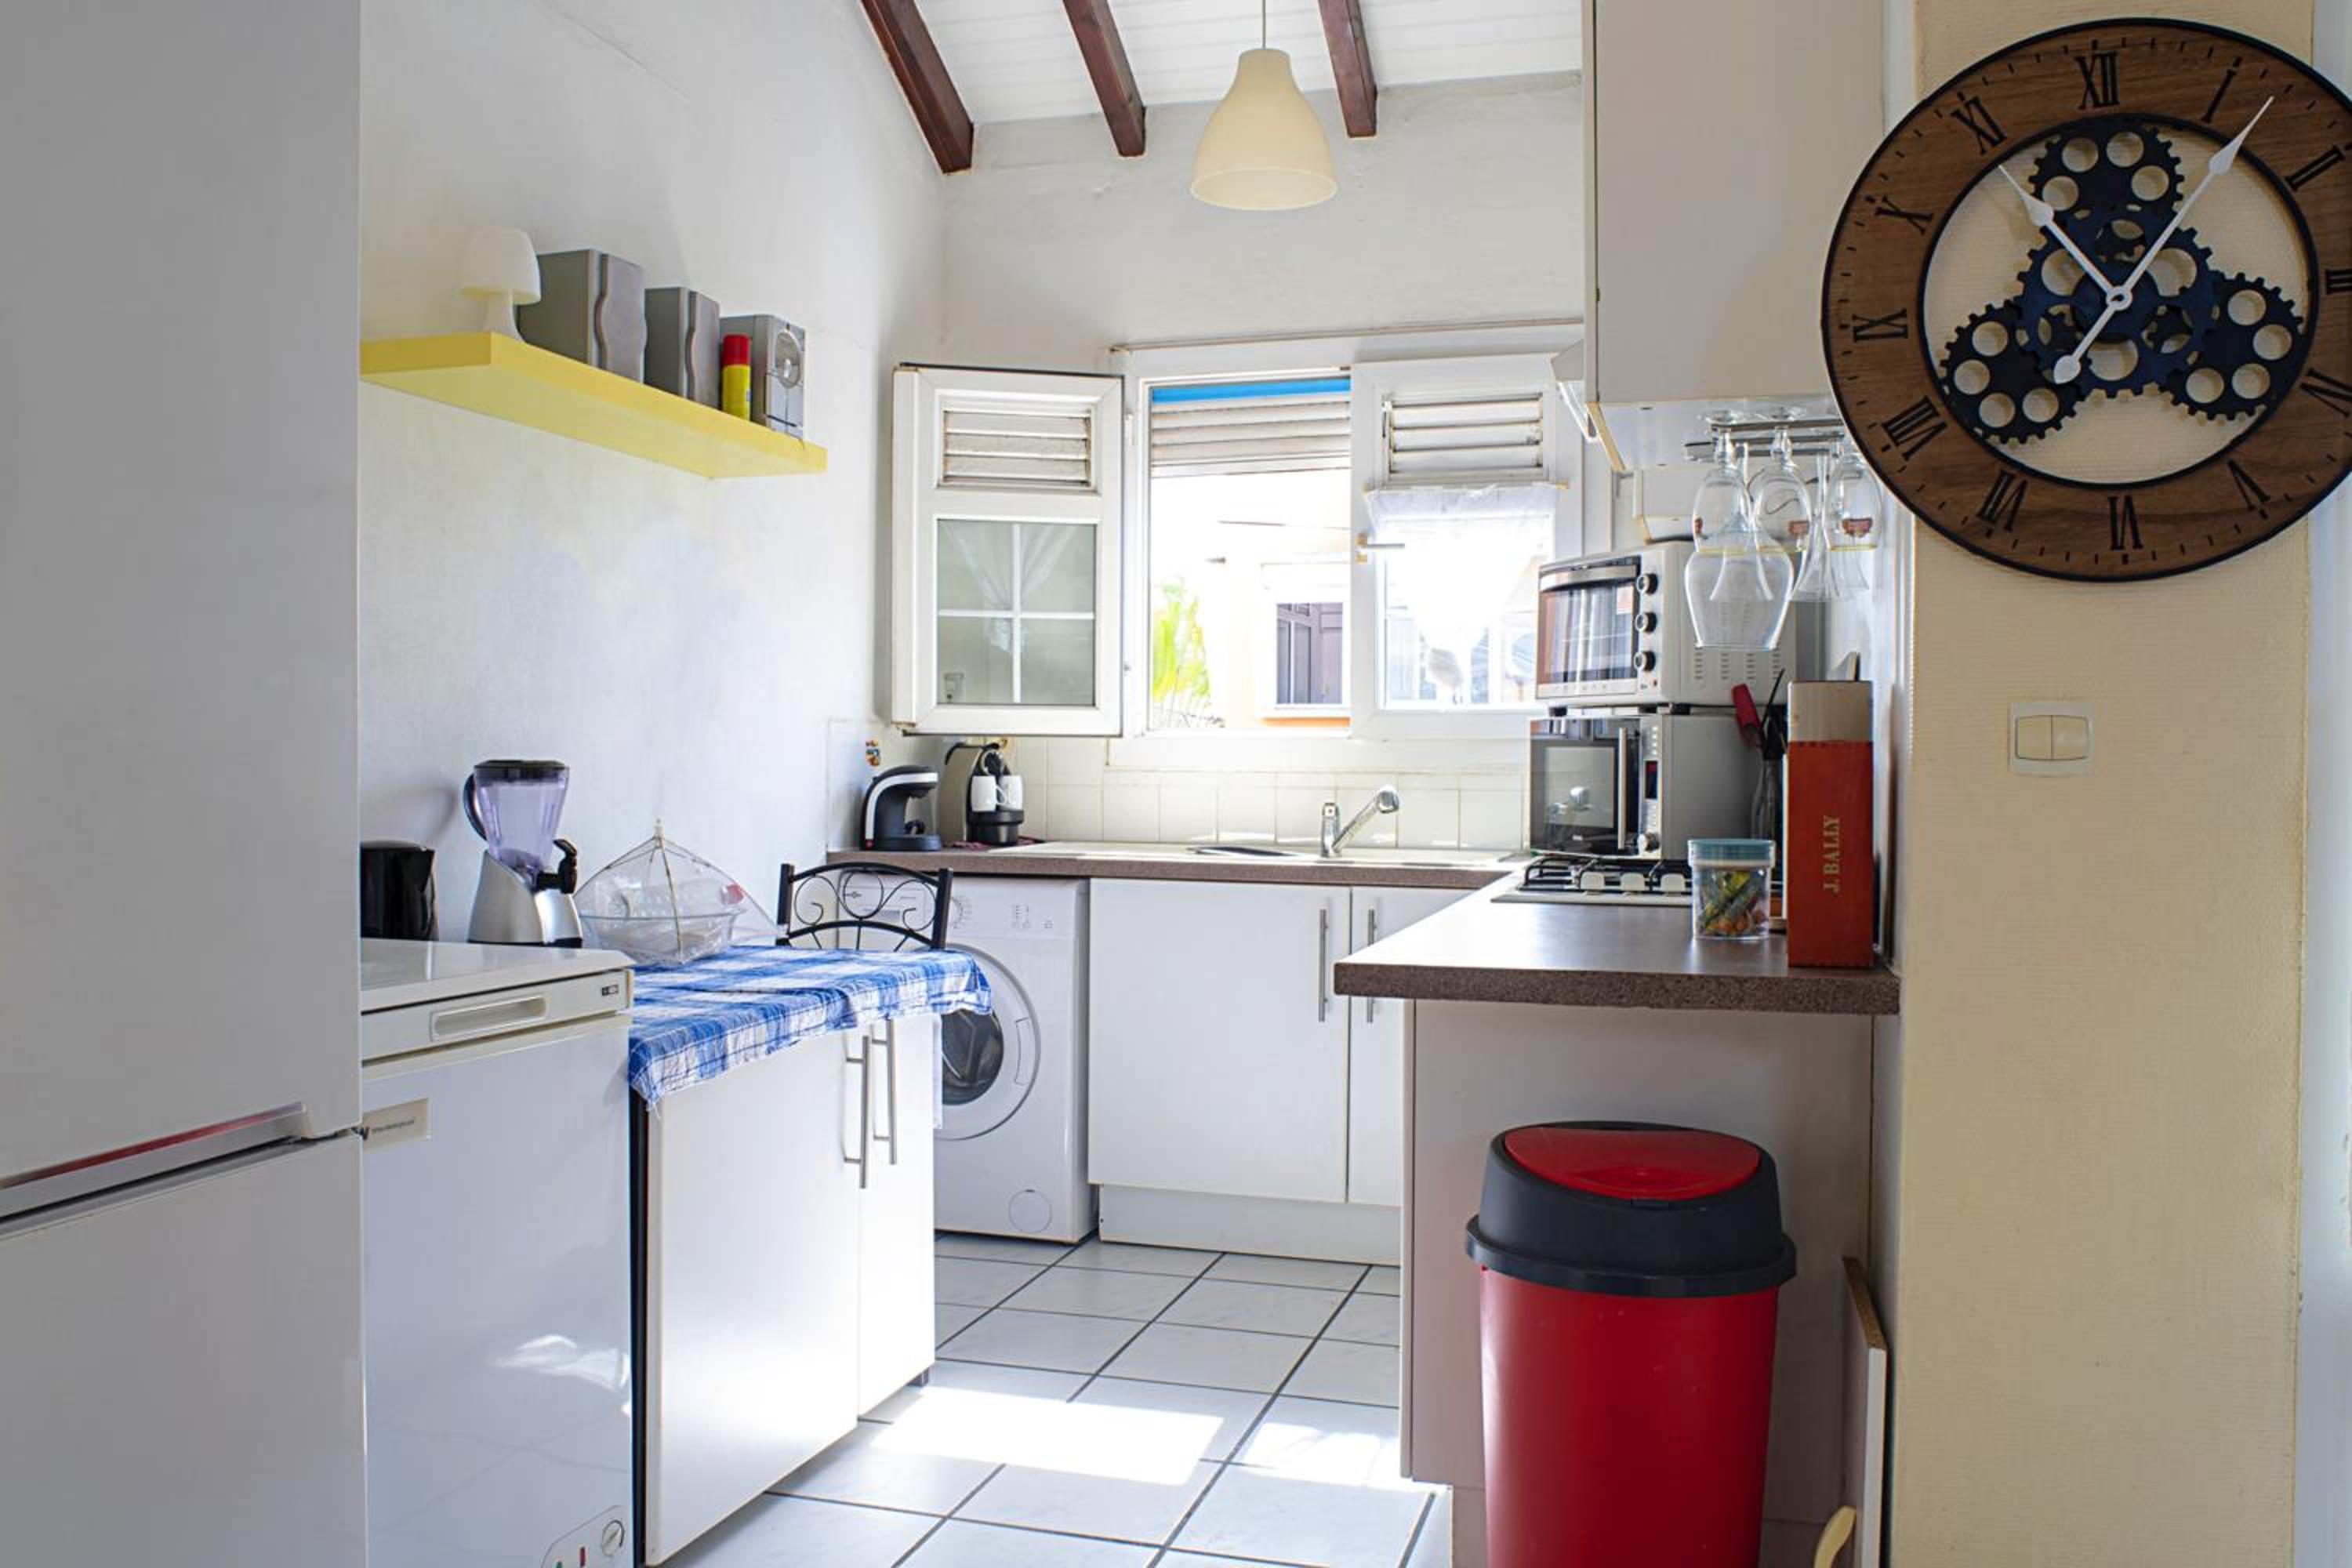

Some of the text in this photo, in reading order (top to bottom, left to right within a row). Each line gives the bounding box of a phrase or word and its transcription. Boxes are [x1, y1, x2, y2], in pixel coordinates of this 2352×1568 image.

[2074, 52, 2120, 109] XII
[2201, 69, 2237, 123] I
[1951, 96, 2007, 155] XI
[2285, 144, 2345, 191] II
[1875, 196, 1933, 235] X
[1852, 309, 1907, 342] IX
[1882, 395, 1947, 461] VIII
[1976, 472, 2028, 532] VII
[2228, 459, 2270, 510] V
[2107, 495, 2144, 551] VI
[1822, 815, 1841, 894] J. BALLY
